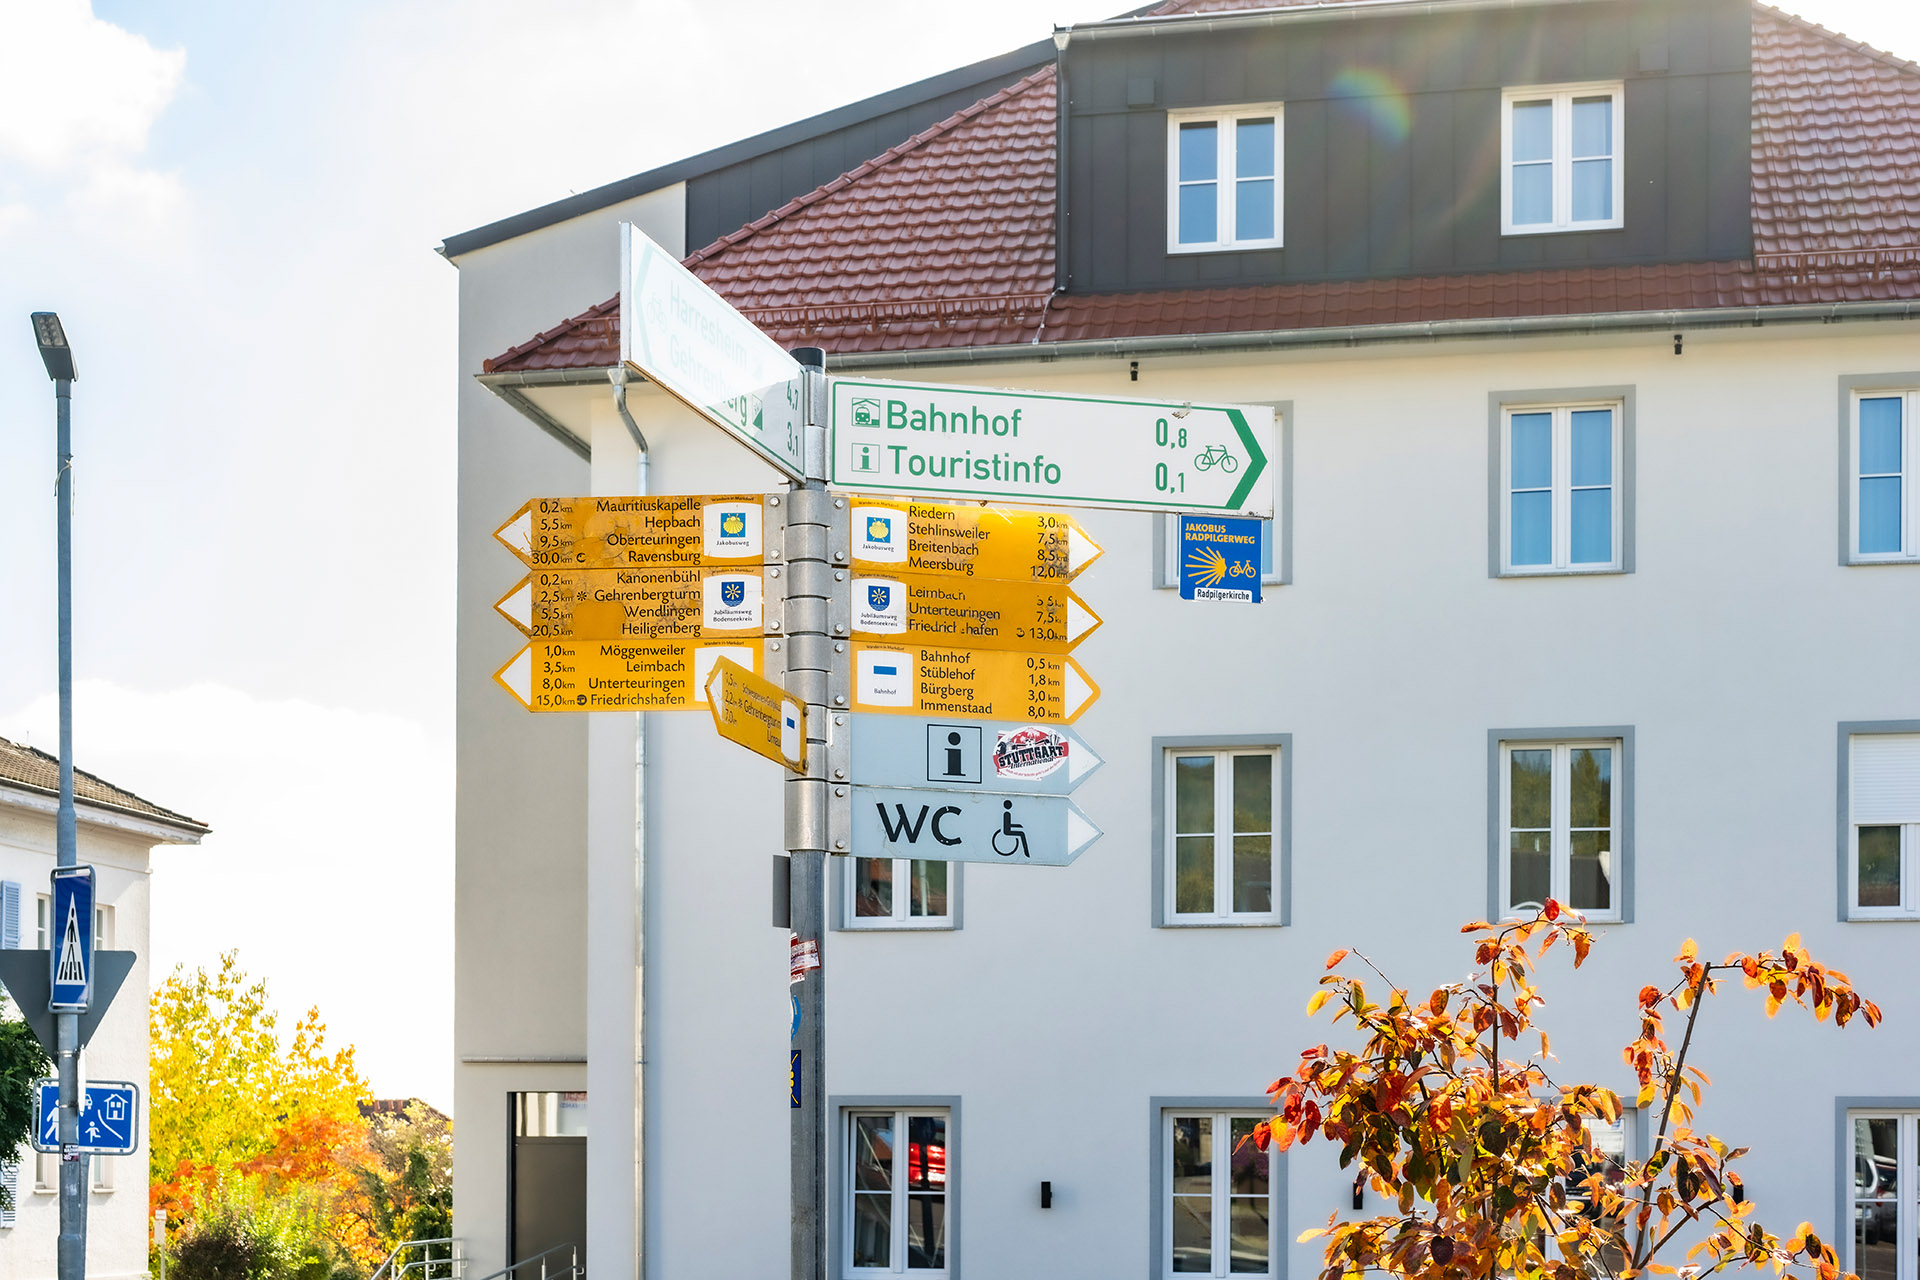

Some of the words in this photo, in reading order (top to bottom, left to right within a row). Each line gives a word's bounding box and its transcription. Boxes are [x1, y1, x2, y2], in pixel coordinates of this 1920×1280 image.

[670, 280, 748, 368] Harresheim
[787, 380, 798, 410] 4,7
[886, 400, 1022, 438] Bahnhof
[1156, 418, 1188, 450] 0,8
[788, 422, 798, 456] 3,1
[888, 445, 1062, 486] Touristinfo
[1156, 462, 1185, 494] 0,1
[596, 498, 700, 514] Mauritiuskapelle
[909, 506, 955, 520] Riedern
[645, 515, 700, 531] Hepbach
[1185, 523, 1226, 533] JAKOBUS
[908, 522, 990, 540] Stehlinsweiler
[1185, 533, 1255, 544] RADPILGERWEG
[607, 533, 700, 548] Oberteuringen
[909, 539, 978, 555] Breitenbach
[628, 550, 700, 565] Ravensburg
[909, 557, 974, 576] Meersburg
[617, 570, 700, 584] Kanonenbühl
[594, 589, 700, 604] Gehrenbergturm
[1197, 589, 1250, 600] Radpilgerkirche
[624, 606, 700, 620] Wendlingen
[909, 602, 1000, 622] Unterteuringen
[622, 623, 701, 638] Heiligenberg
[909, 619, 998, 636] Friedrichafen
[600, 644, 685, 659] Möggenweiler
[921, 650, 970, 664] Bahnhof
[626, 660, 685, 672] Leimbach
[920, 666, 975, 680] Stüblehof
[588, 677, 685, 692] Unterteuringen
[921, 682, 974, 700] Bürgberg
[591, 693, 685, 705] Friedrichshafen
[921, 699, 992, 714] Immenstaad
[999, 746, 1063, 767] STUTTGART
[876, 802, 962, 846] WC
